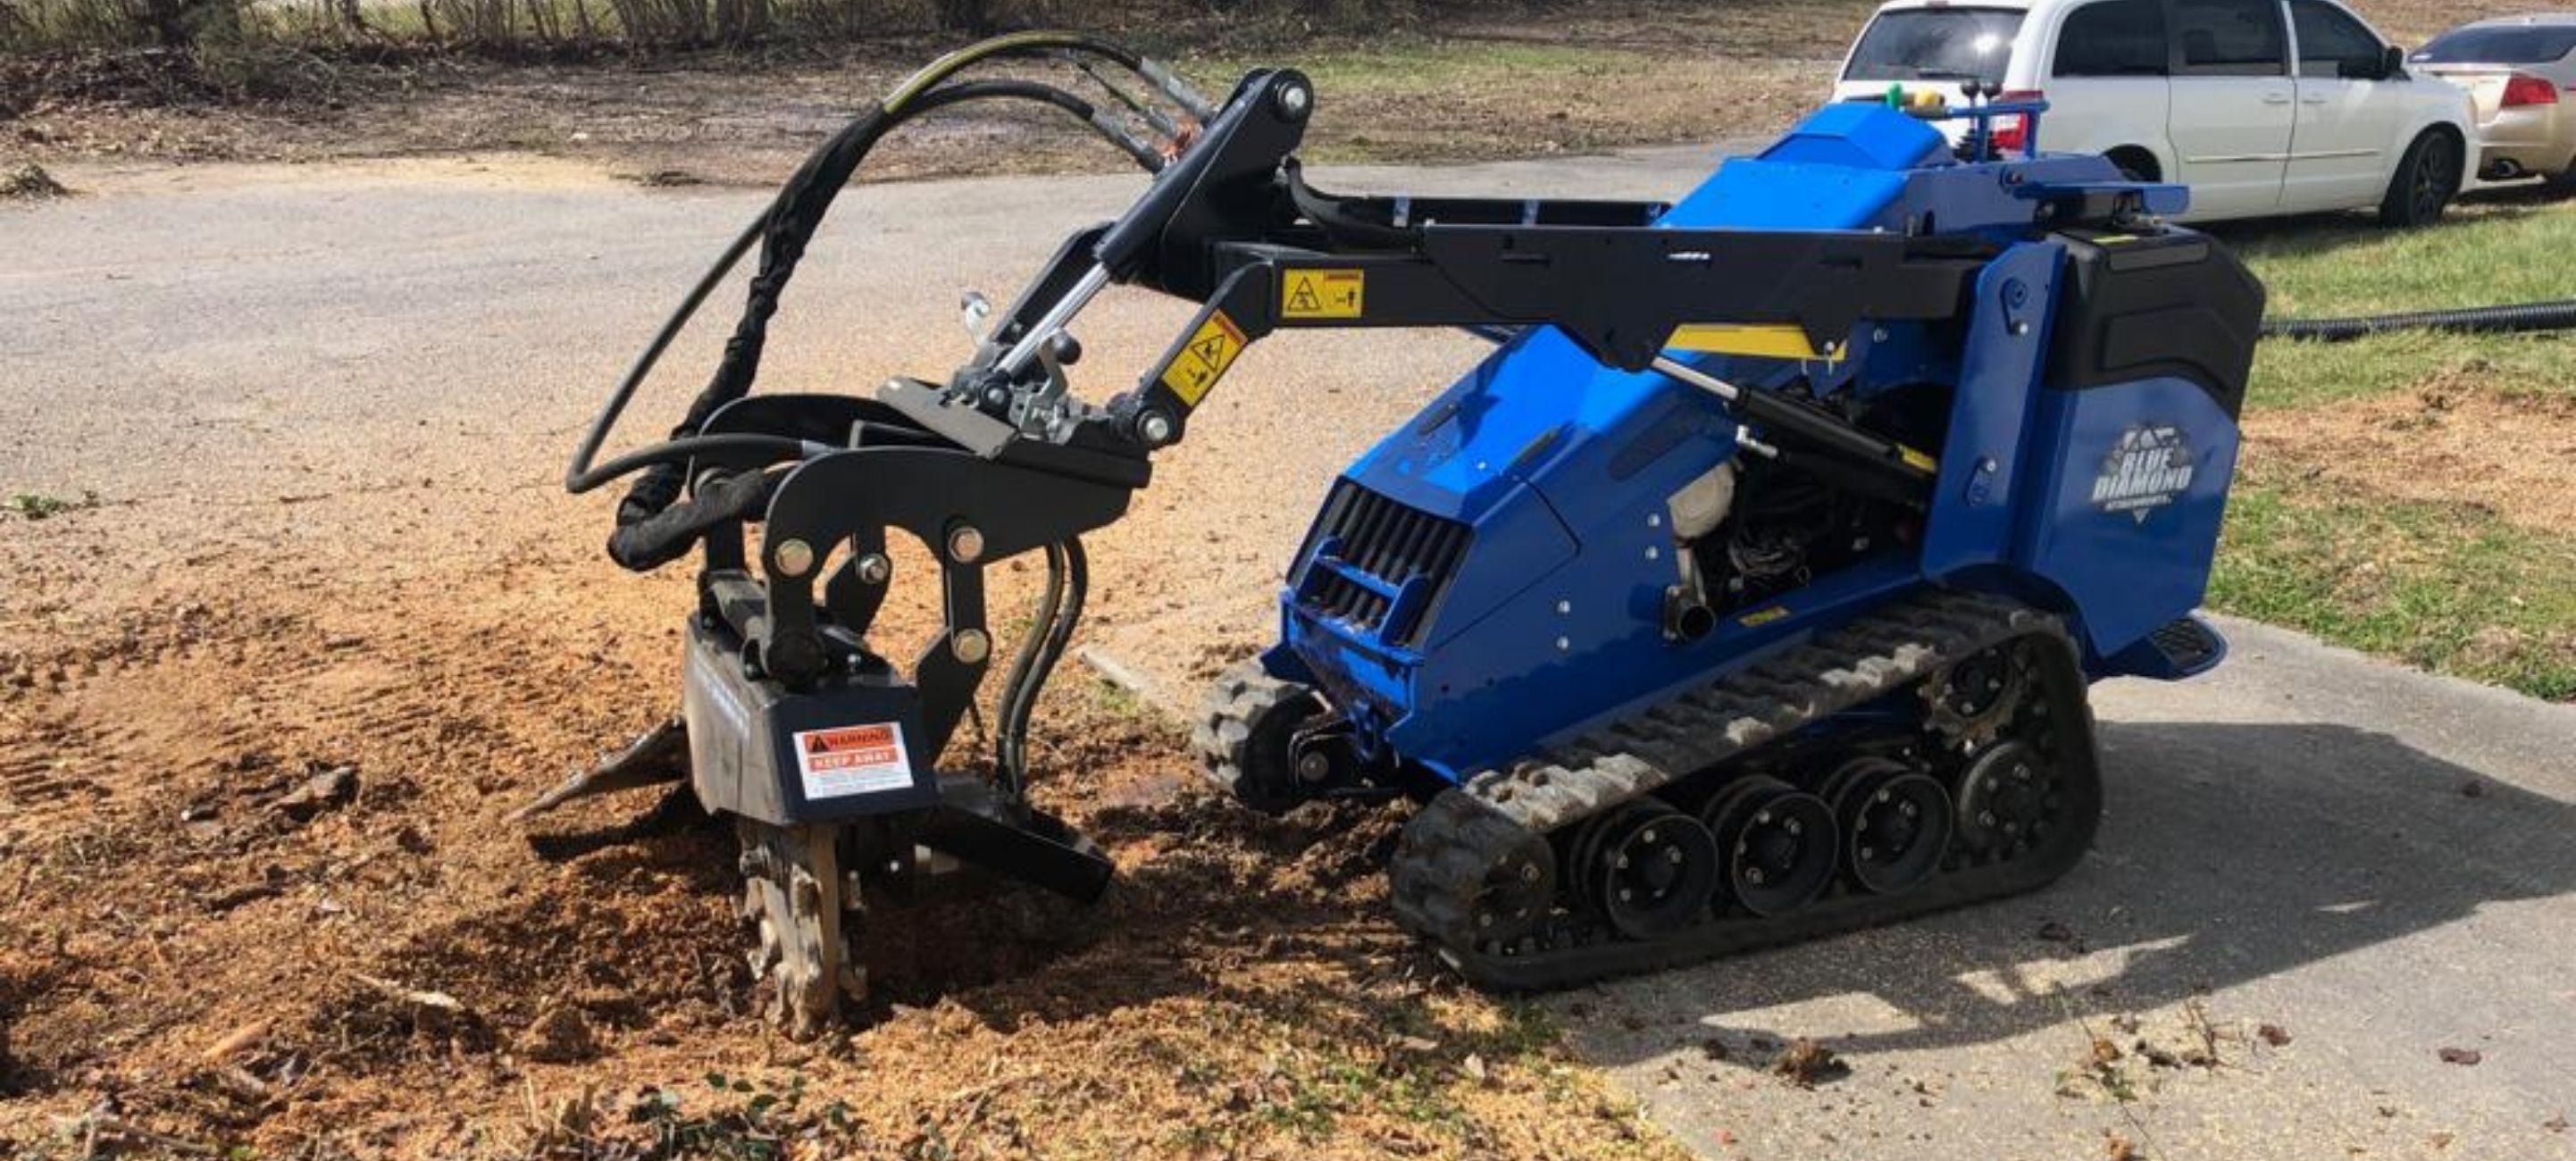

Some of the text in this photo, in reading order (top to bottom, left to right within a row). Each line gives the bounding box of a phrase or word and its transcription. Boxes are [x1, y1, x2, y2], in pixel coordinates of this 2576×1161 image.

[2121, 447, 2174, 470] BLUE
[2092, 465, 2194, 500] DIAMOND
[826, 728, 889, 747] WARNING
[814, 748, 890, 769] KEEP AWAY
